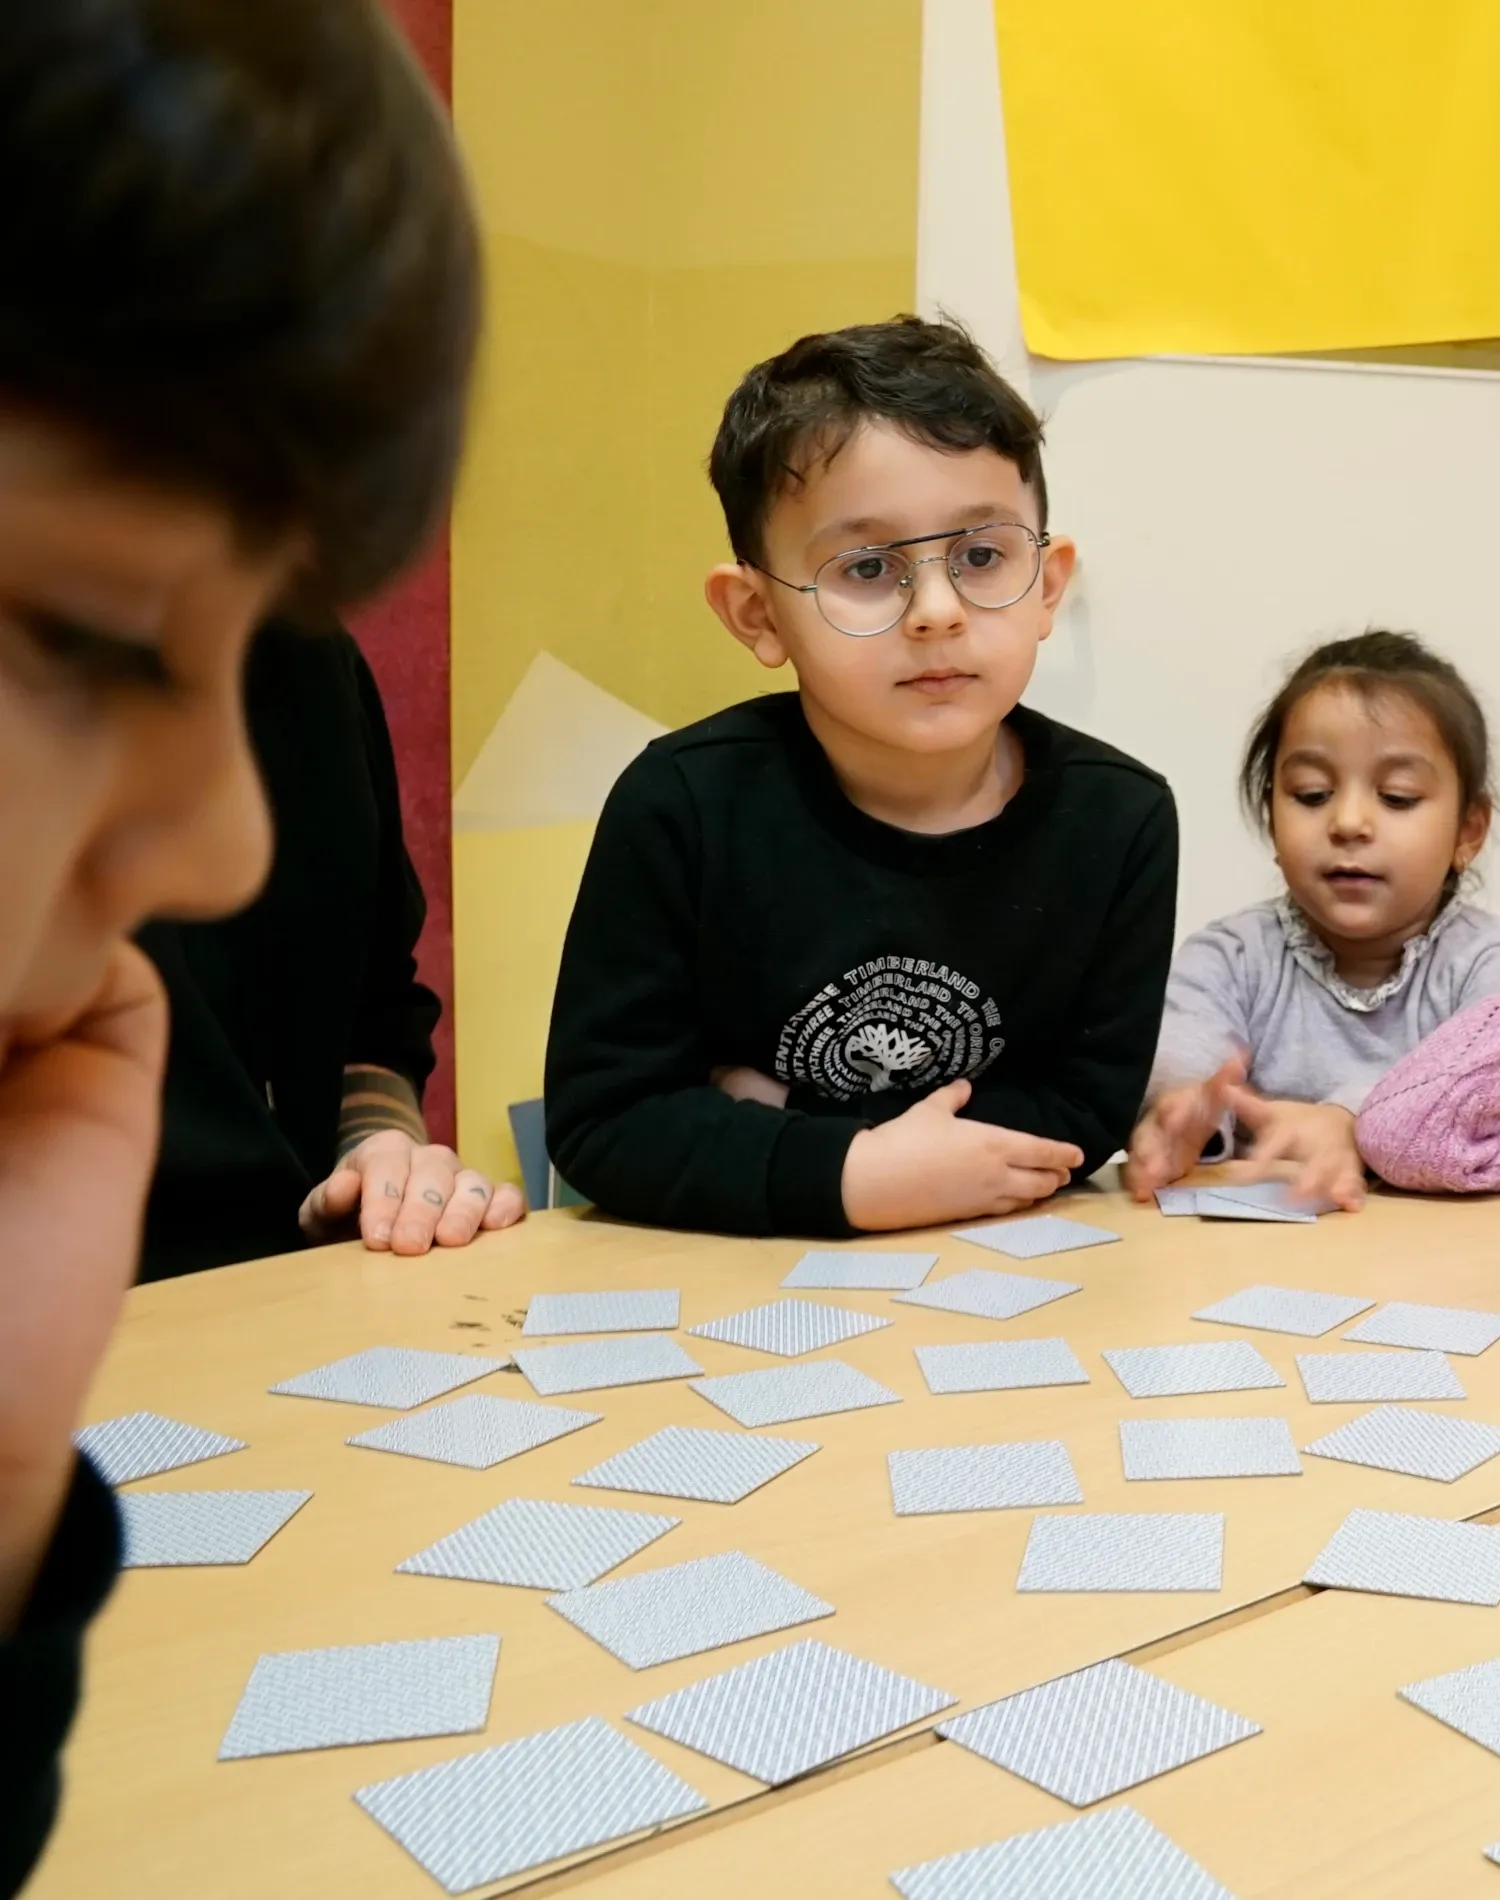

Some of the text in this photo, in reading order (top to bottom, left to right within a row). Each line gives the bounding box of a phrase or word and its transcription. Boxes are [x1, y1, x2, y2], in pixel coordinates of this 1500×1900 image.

[838, 973, 951, 1008] TIMBERLAND
[843, 956, 981, 1000] TIMBERLAND
[981, 997, 1002, 1028] THE
